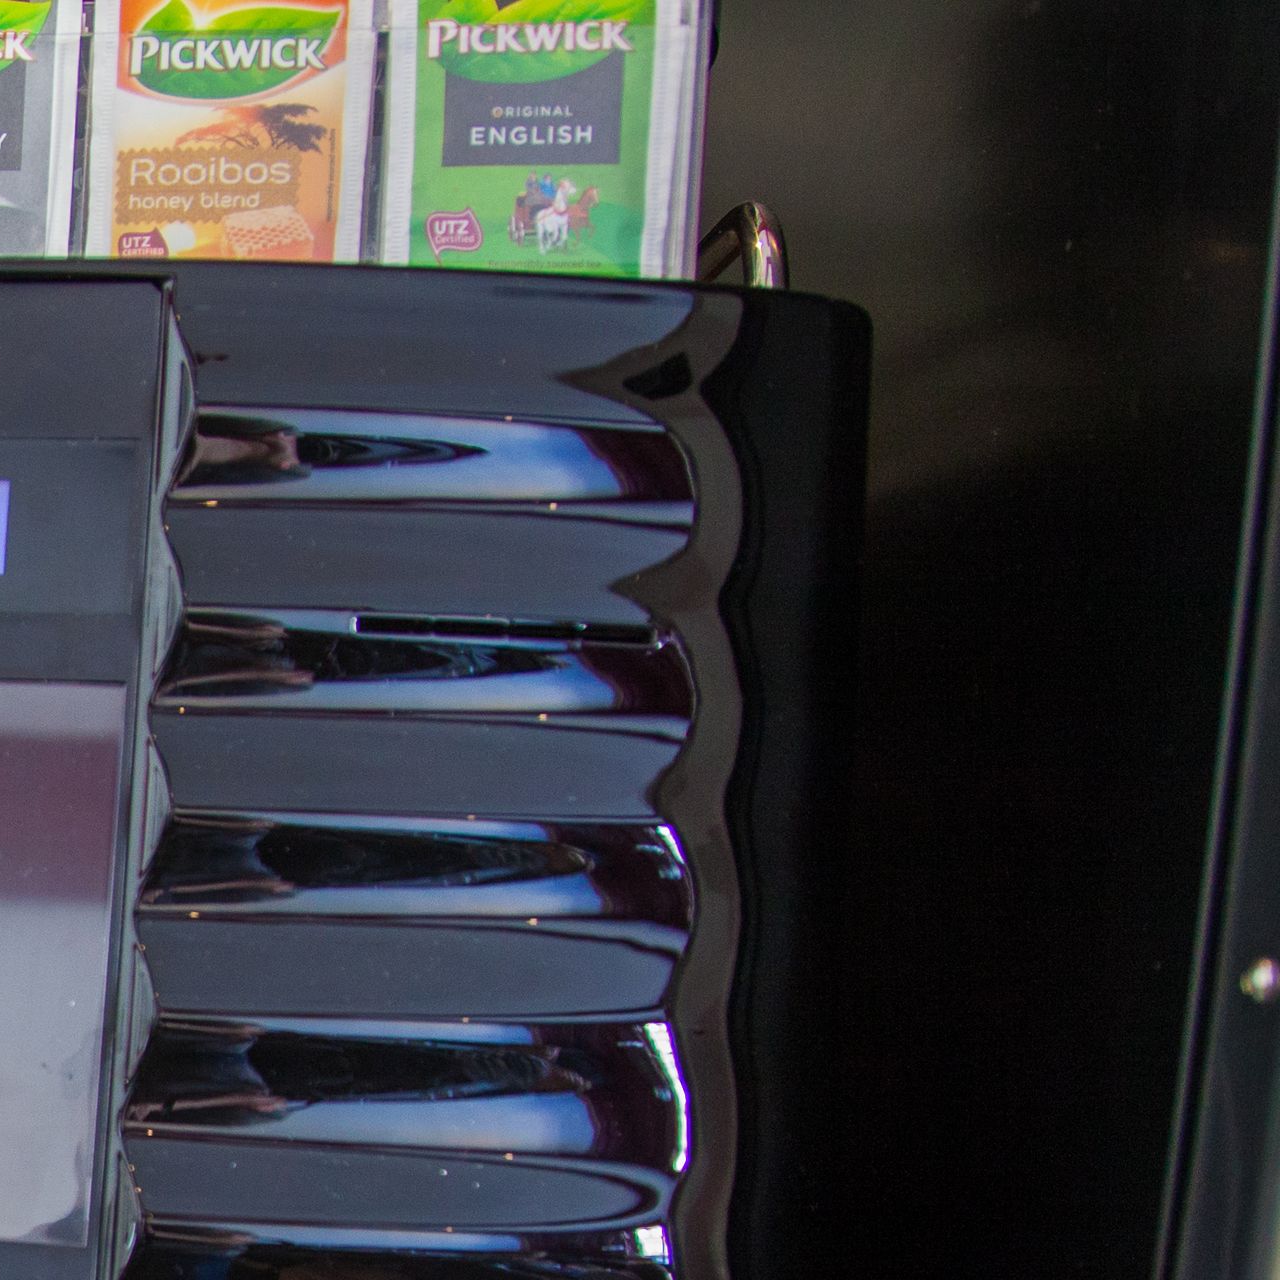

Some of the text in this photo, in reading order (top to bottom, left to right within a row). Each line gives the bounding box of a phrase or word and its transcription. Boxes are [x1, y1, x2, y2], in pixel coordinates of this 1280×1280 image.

[427, 18, 632, 60] PICKWICK
[129, 33, 327, 76] PICKWICK
[492, 104, 574, 119] ORIGINAL
[470, 123, 593, 147] ENGLISH
[129, 157, 291, 186] Rooibos
[128, 191, 261, 212] honey blend
[434, 220, 468, 235] UTZ
[121, 236, 151, 249] UTZ
